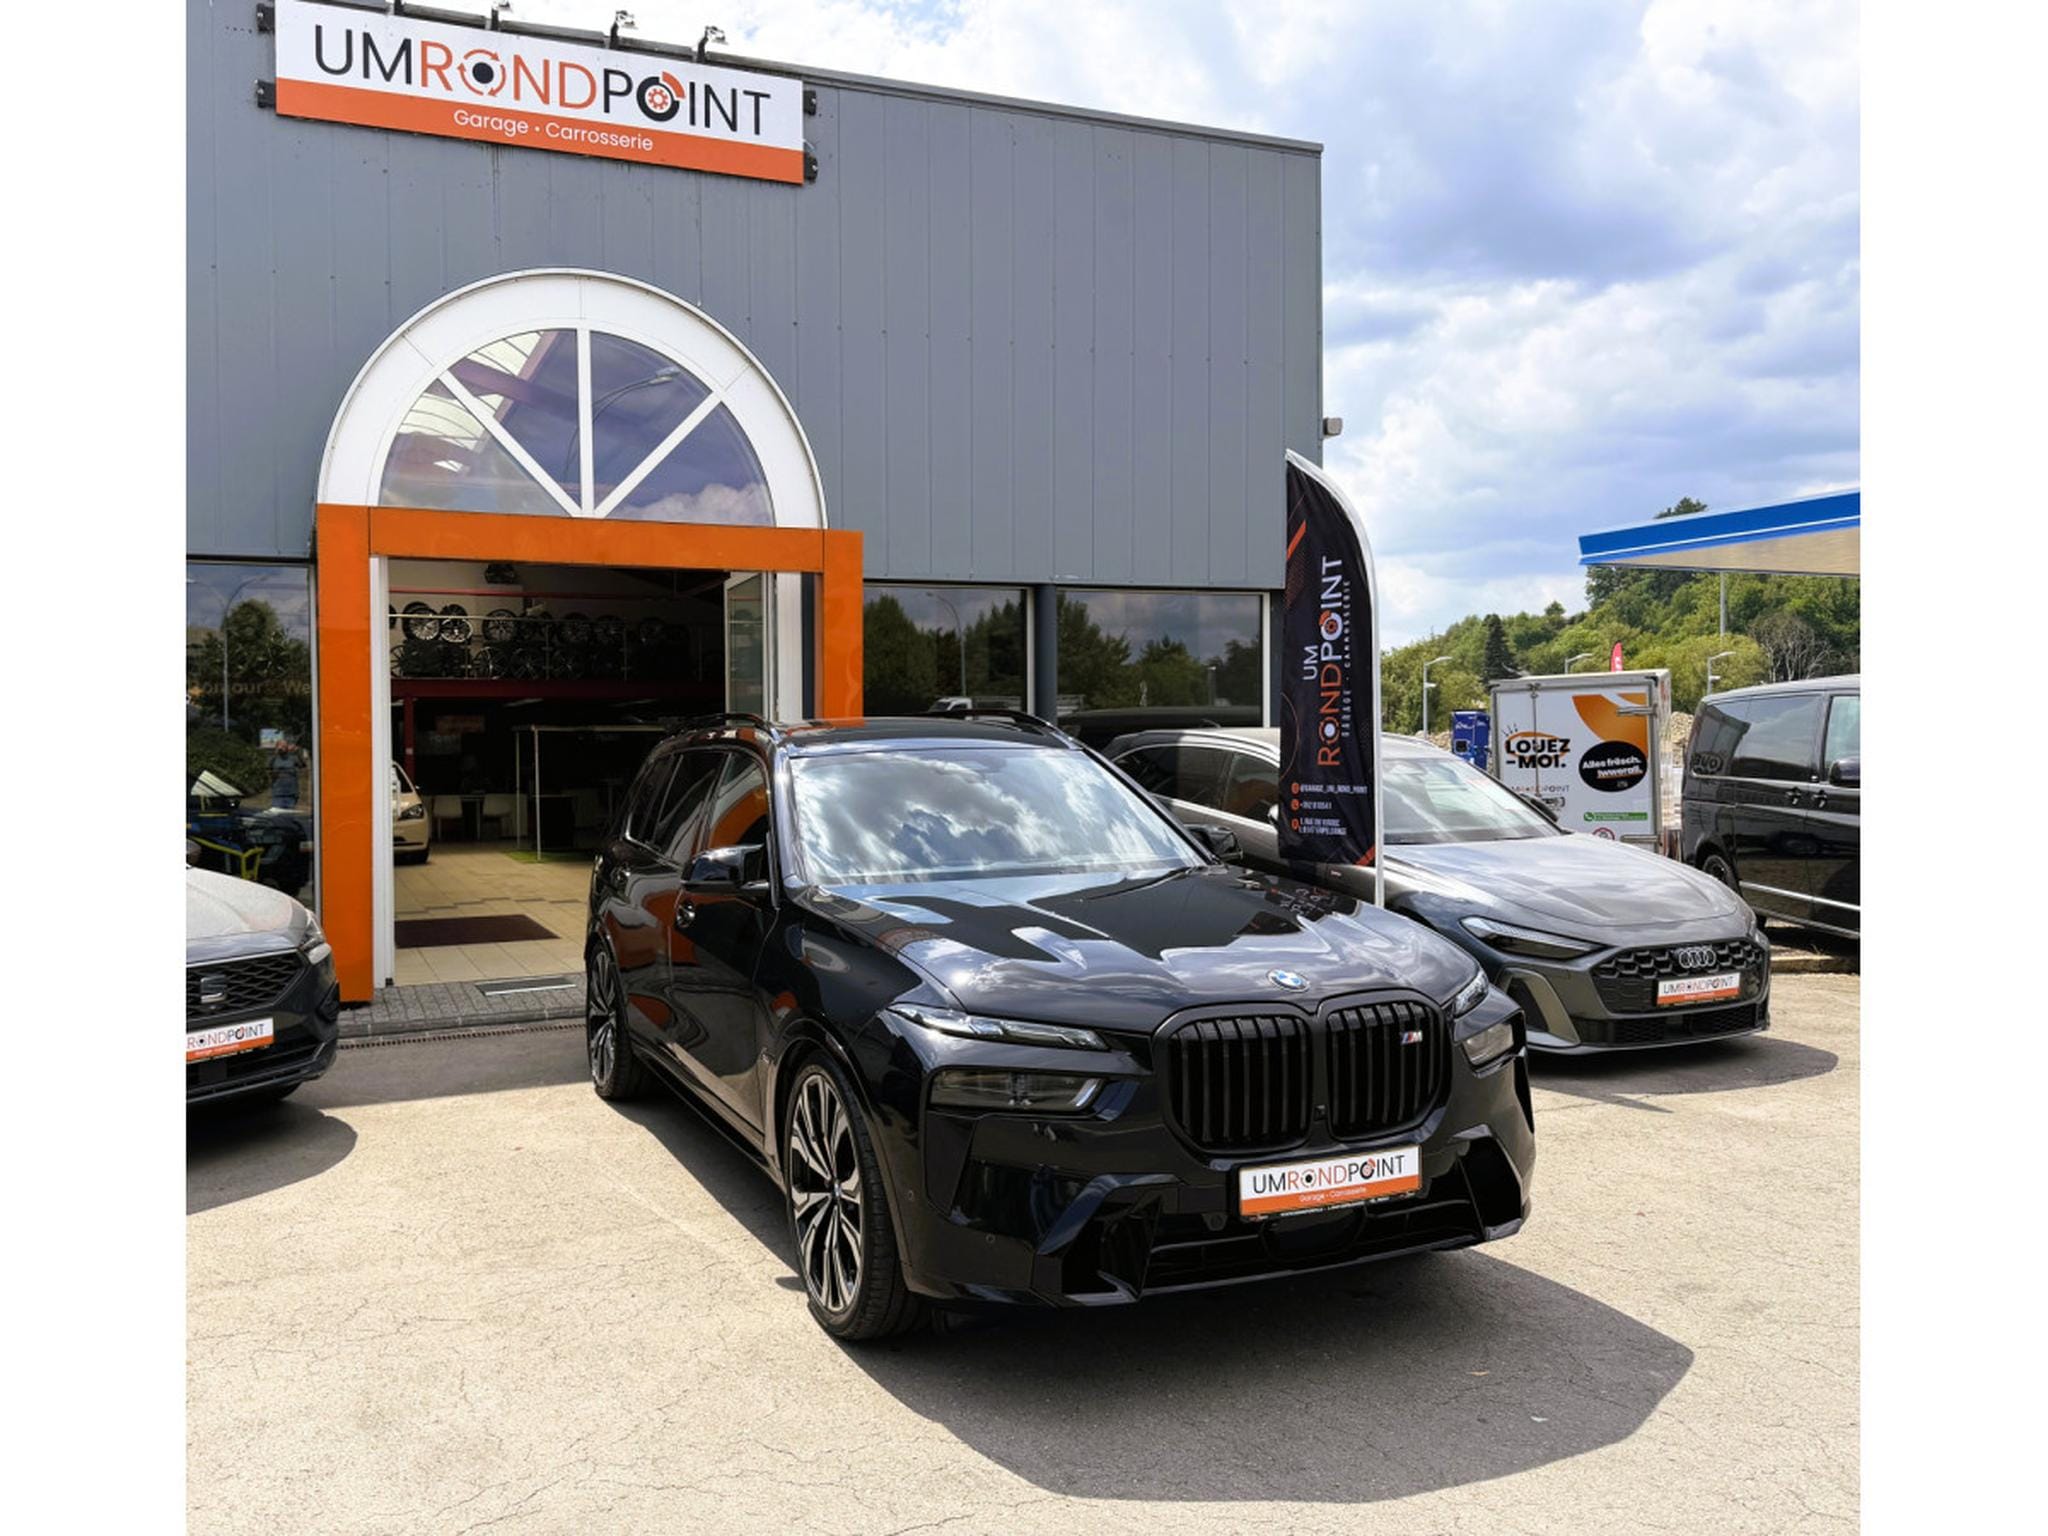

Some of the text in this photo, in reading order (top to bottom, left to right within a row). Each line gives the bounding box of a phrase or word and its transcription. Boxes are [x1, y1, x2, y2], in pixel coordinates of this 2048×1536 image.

[314, 25, 770, 136] UMRONDPOINT
[453, 109, 654, 152] Garage Carrosserie
[1302, 645, 1318, 680] UM
[1317, 555, 1343, 766] RONDPOINT
[1506, 739, 1571, 754] LOUEZ
[1582, 759, 1606, 769] Alles
[1253, 1154, 1405, 1194] UMRONDPOINT
